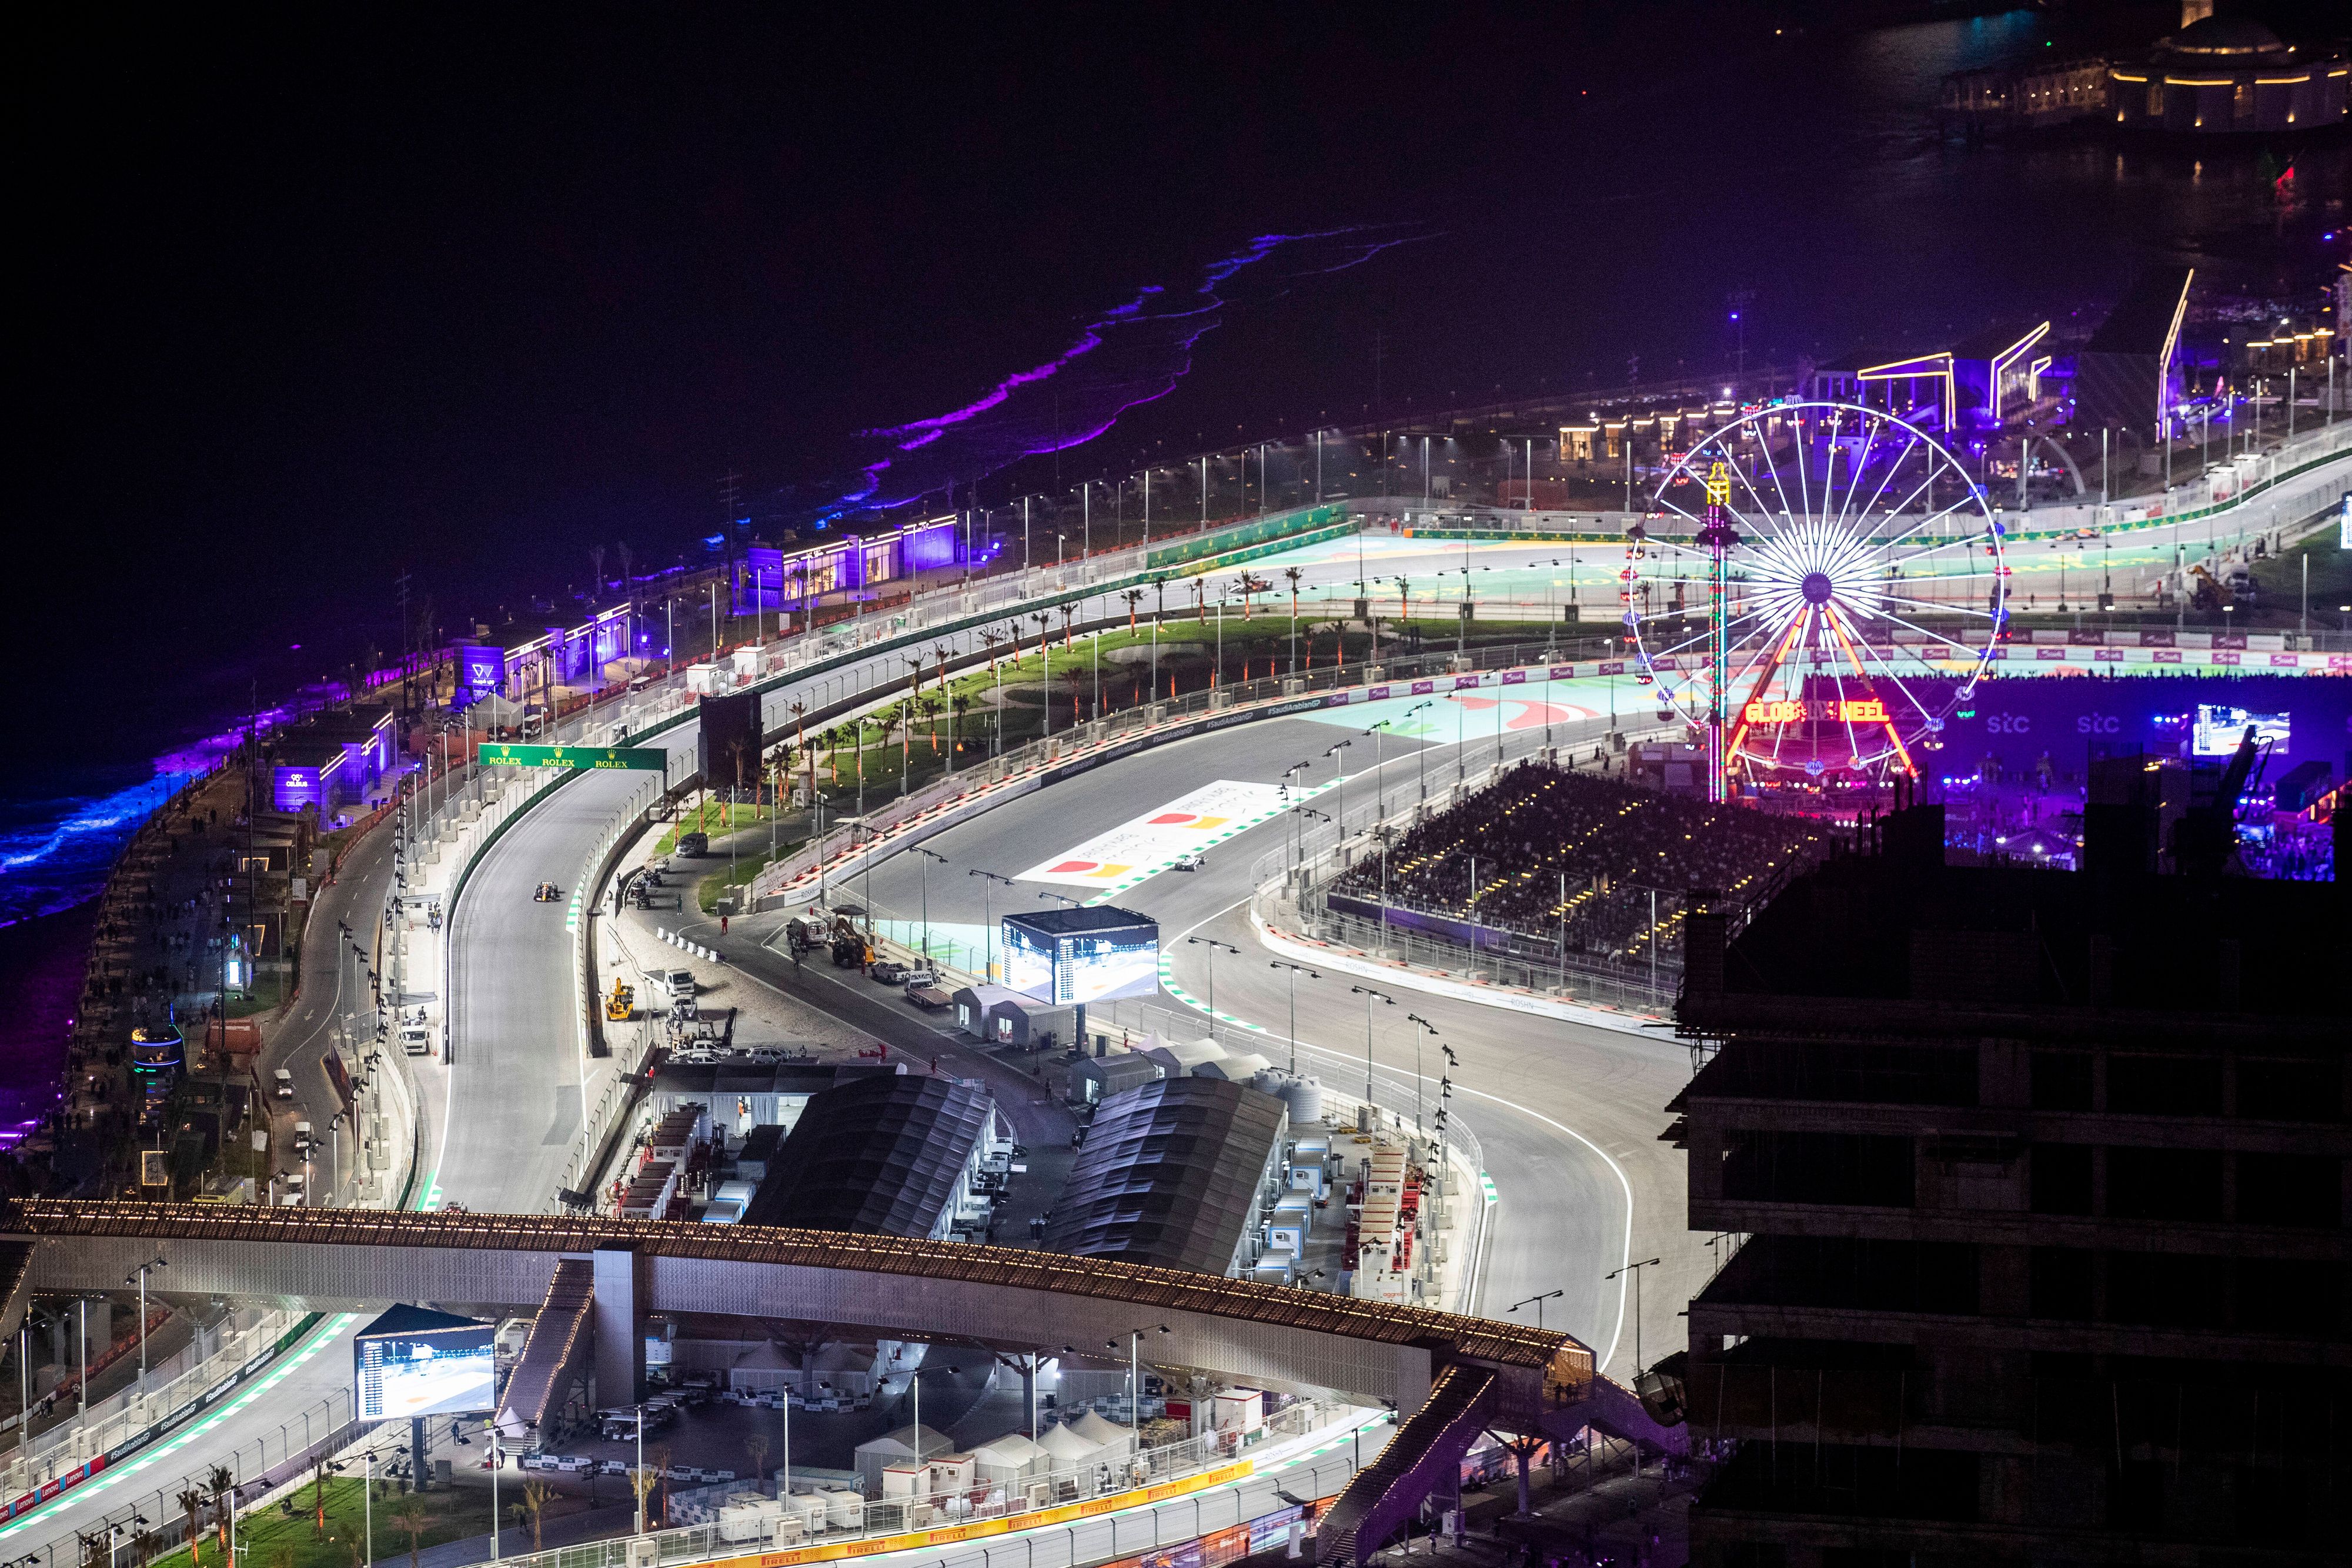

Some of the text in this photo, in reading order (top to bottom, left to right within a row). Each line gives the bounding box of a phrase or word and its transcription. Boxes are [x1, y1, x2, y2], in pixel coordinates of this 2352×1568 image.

[1987, 711, 2030, 733] stc
[2077, 711, 2120, 733] stc
[489, 757, 522, 765] ROLEX
[542, 758, 575, 767] ROLEX
[801, 888, 816, 899] ROSHN
[1345, 961, 1368, 974] ROSHN
[1511, 997, 1534, 1010] ROSHN
[67, 1470, 83, 1484] Lenovo
[1208, 1467, 1235, 1484] PIRELLI
[42, 1483, 59, 1497] Lenovo
[1148, 1484, 1177, 1500] PIRELLI
[17, 1497, 34, 1510] Lenovo
[1081, 1499, 1112, 1515] PIRELLI
[1008, 1514, 1041, 1530] PIRELLI
[930, 1527, 966, 1543] PIRELLI
[847, 1540, 885, 1555] PIRELLI
[761, 1552, 800, 1566] PIRELLI
